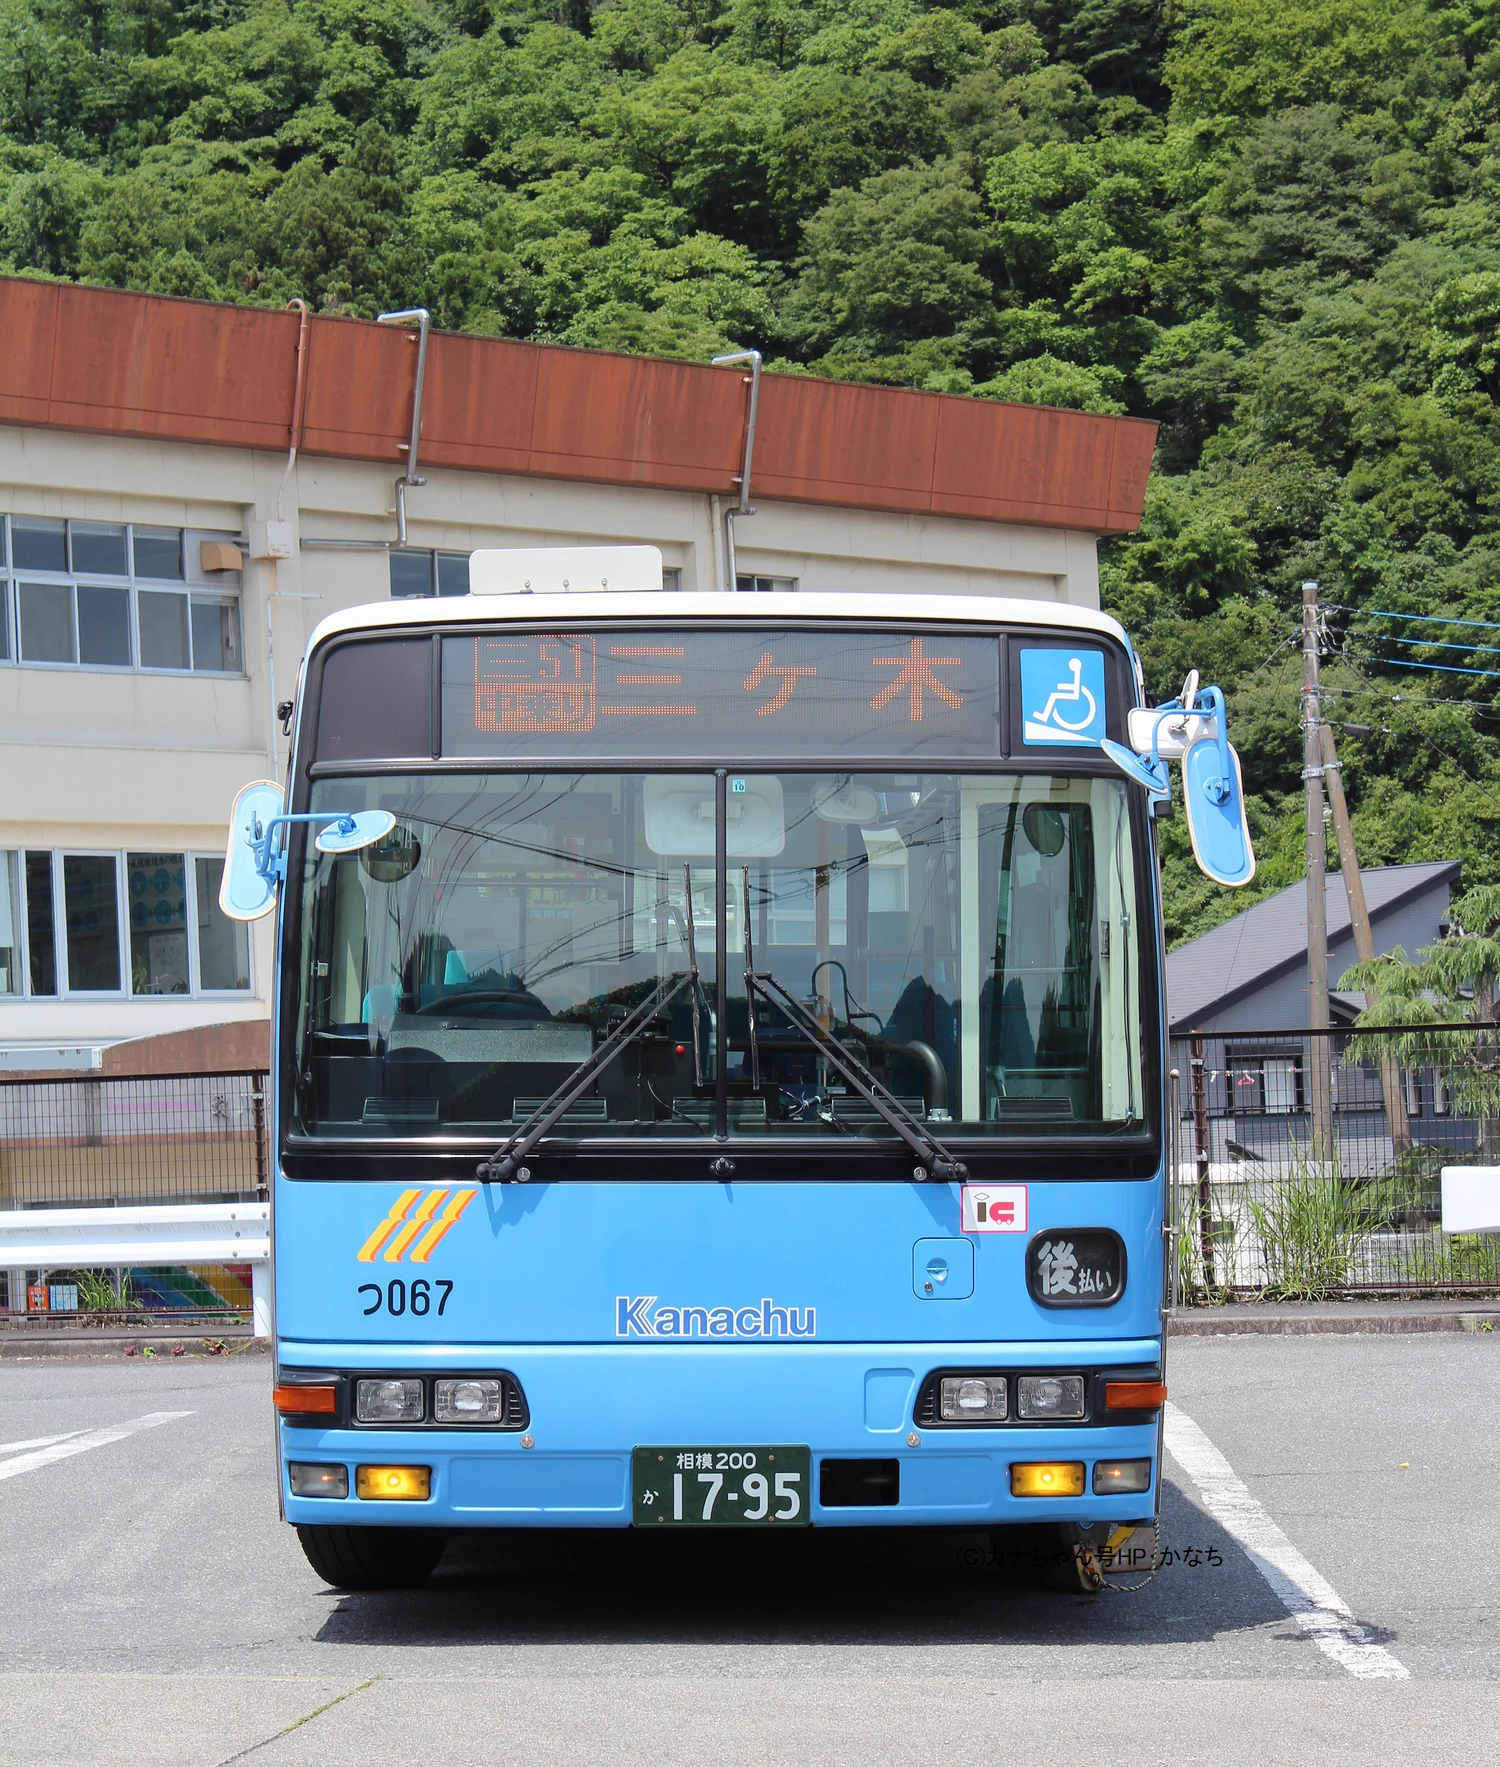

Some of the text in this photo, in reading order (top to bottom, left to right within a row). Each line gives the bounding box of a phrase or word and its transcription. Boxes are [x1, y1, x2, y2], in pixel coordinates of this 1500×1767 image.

[483, 643, 582, 678] 三51
[480, 689, 592, 725] 中乗り
[1037, 1240, 1113, 1295] 後払い
[357, 1278, 454, 1317] つ067
[615, 1295, 817, 1337] Kanachu
[642, 1472, 801, 1520] か 17-95
